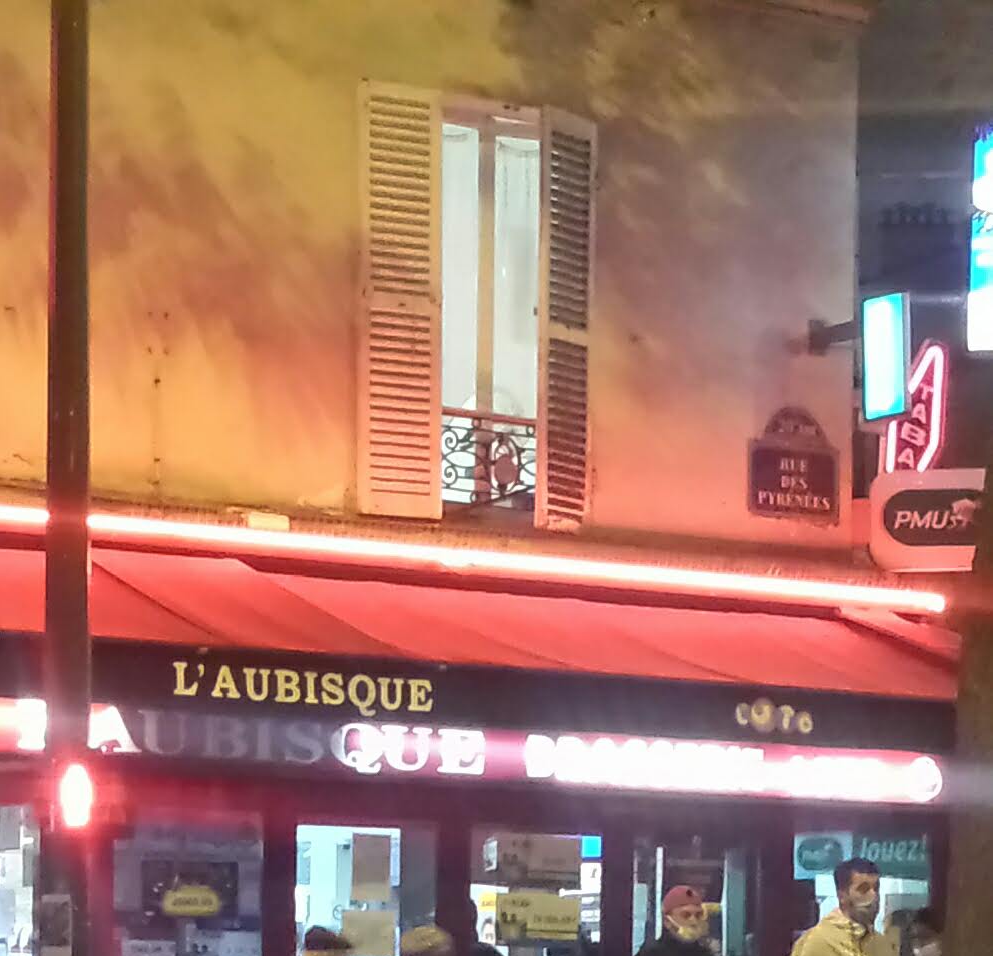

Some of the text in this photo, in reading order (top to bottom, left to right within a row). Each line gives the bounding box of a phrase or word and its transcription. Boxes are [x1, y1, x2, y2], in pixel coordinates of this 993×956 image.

[781, 475, 808, 489] DES
[894, 510, 949, 530] PMU
[173, 661, 433, 717] L'AUBISQUE
